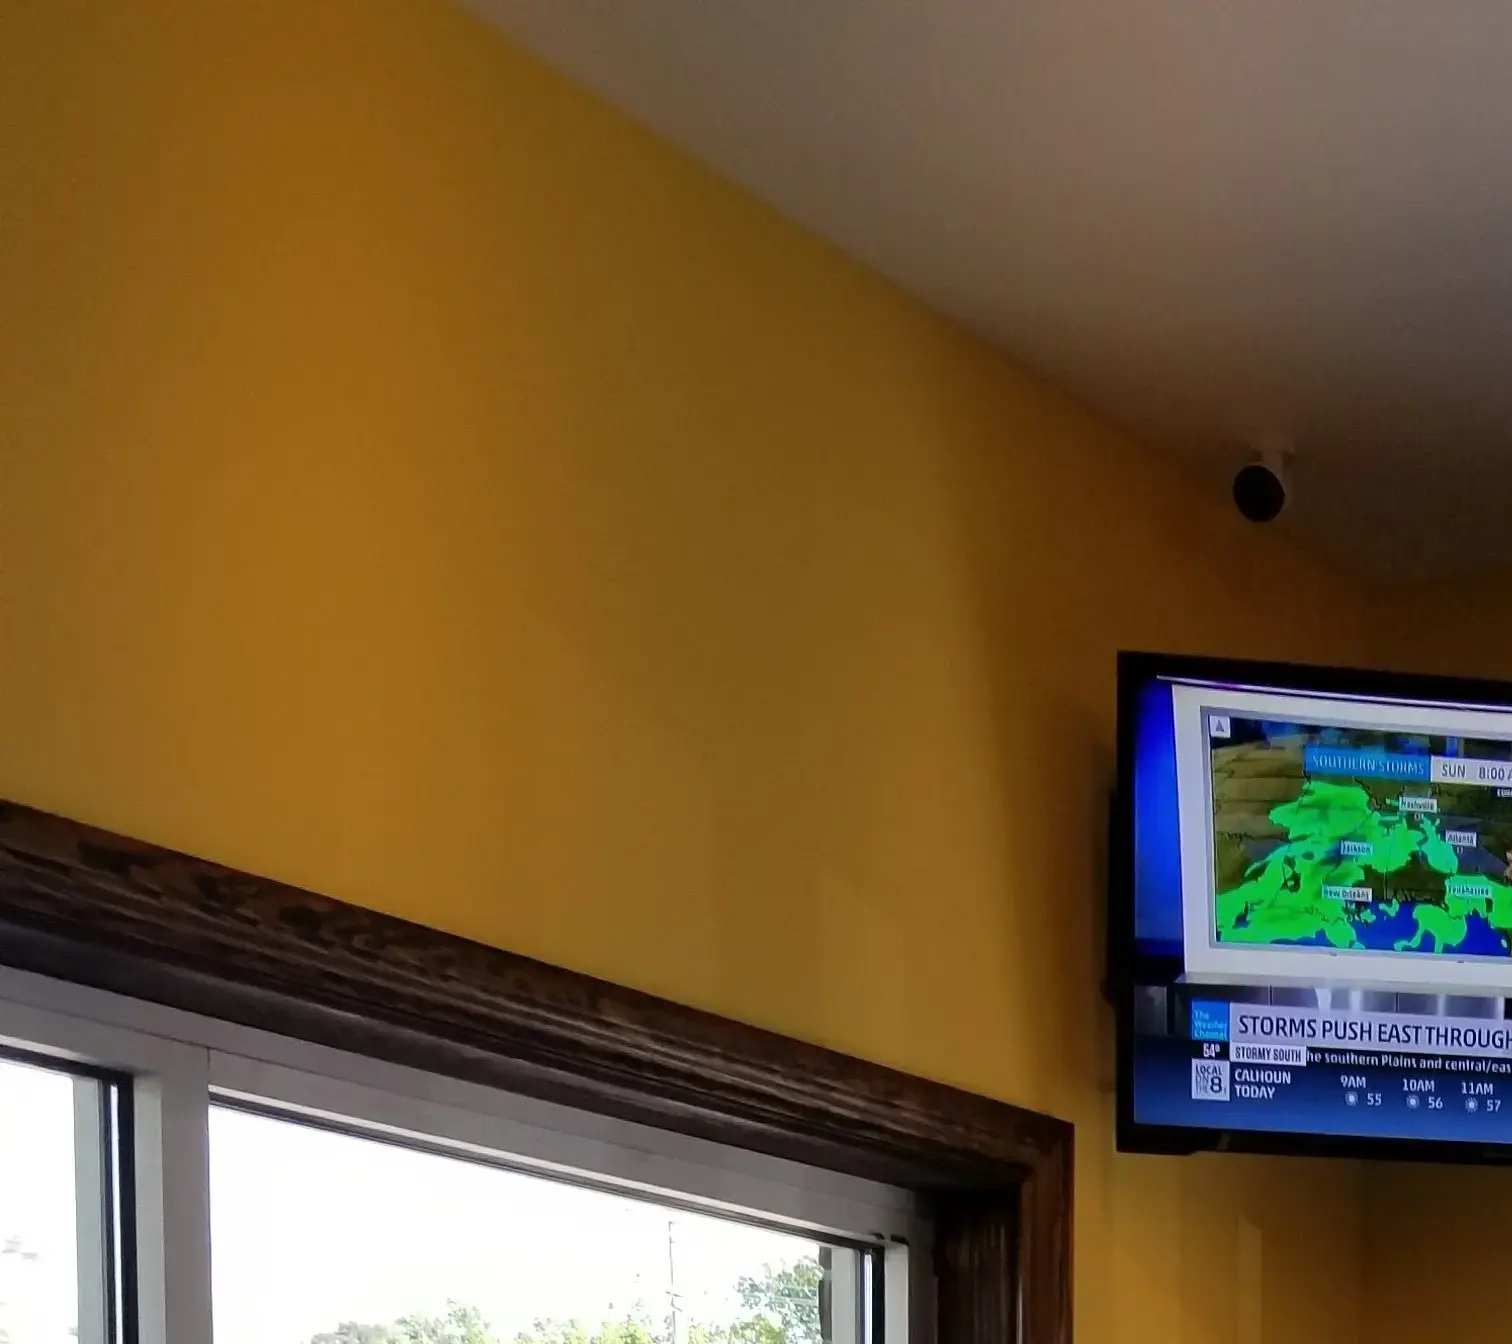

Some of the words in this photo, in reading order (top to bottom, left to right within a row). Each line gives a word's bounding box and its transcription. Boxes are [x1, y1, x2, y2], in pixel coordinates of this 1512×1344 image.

[1441, 763, 1466, 778] SUN
[1478, 764, 1506, 782] 8:00
[1238, 1014, 1317, 1039] STORMS
[1322, 1019, 1373, 1043] PUSH
[1377, 1022, 1423, 1045] EAST
[1235, 1046, 1271, 1062] STORMY
[1272, 1048, 1301, 1063] SOUTH
[1306, 1050, 1322, 1063] he
[1324, 1051, 1379, 1067] southern
[1381, 1054, 1416, 1069] Plains
[1419, 1057, 1442, 1070] and
[1196, 1064, 1223, 1076] LOCAL
[1234, 1067, 1292, 1085] CALHOUN
[1340, 1074, 1367, 1089] 9AM
[1402, 1078, 1435, 1093] 10AM
[1461, 1081, 1494, 1096] 11AM
[1234, 1084, 1276, 1100] TODAY
[1366, 1093, 1382, 1107] 55
[1427, 1096, 1443, 1109] 56
[1486, 1099, 1501, 1112] 57
